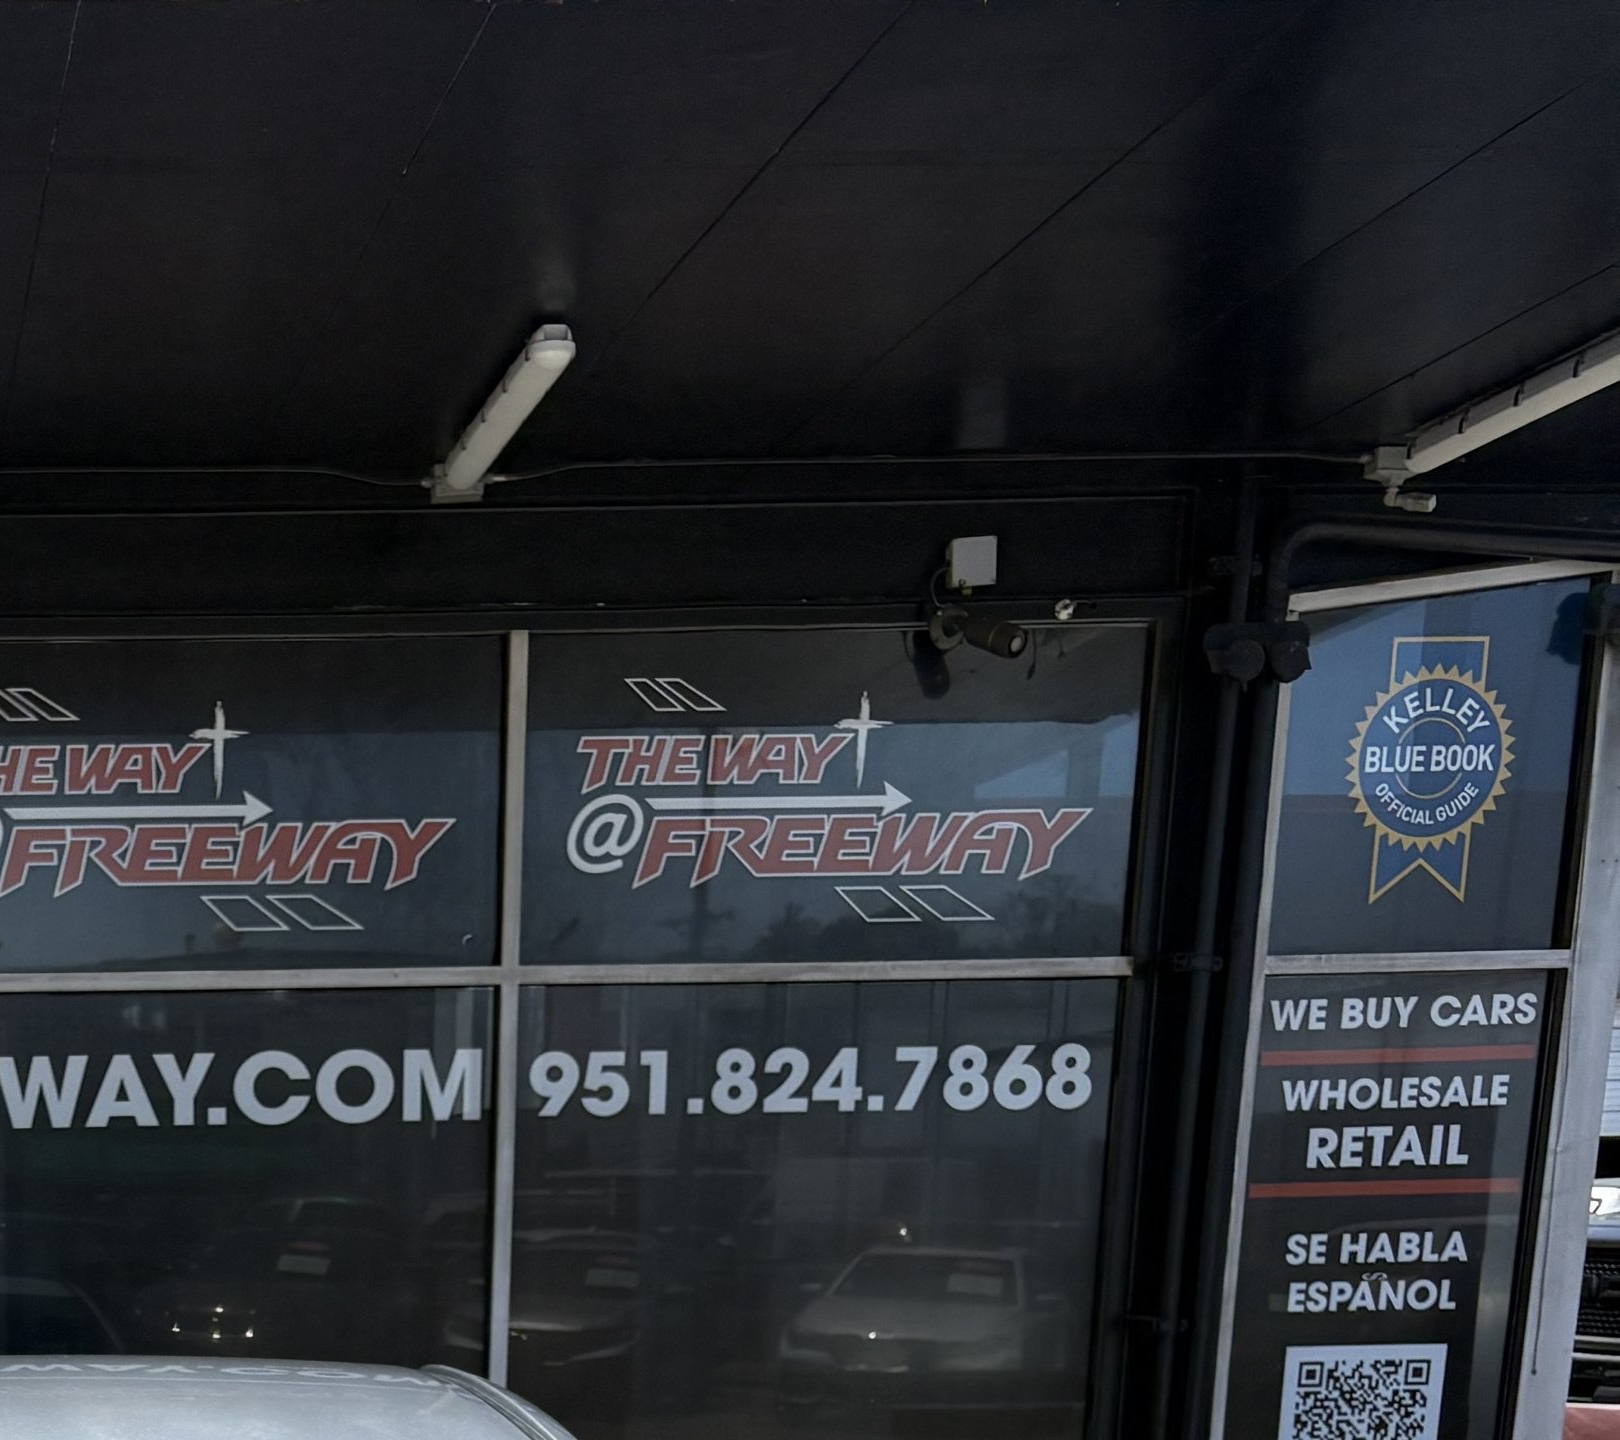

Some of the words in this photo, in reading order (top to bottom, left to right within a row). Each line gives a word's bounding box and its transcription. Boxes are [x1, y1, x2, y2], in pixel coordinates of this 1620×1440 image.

[1383, 688, 1490, 733] KELLEY
[1364, 745, 1427, 773] BLUE
[1430, 743, 1495, 771] BOOK
[1375, 783, 1434, 825] OFFICIAL
[1436, 782, 1479, 822] GUIDE
[1270, 999, 1328, 1031] WE
[1340, 996, 1419, 1030] BUY
[1430, 993, 1538, 1027] CARS
[529, 1043, 1092, 1117] 951.824.7868
[1282, 1074, 1510, 1112] WHOLESALE
[1306, 1124, 1468, 1169] RETAIL
[1285, 1233, 1328, 1266] SE
[1340, 1231, 1467, 1264] HABLA
[1287, 1272, 1456, 1313] ESPAÑOL
